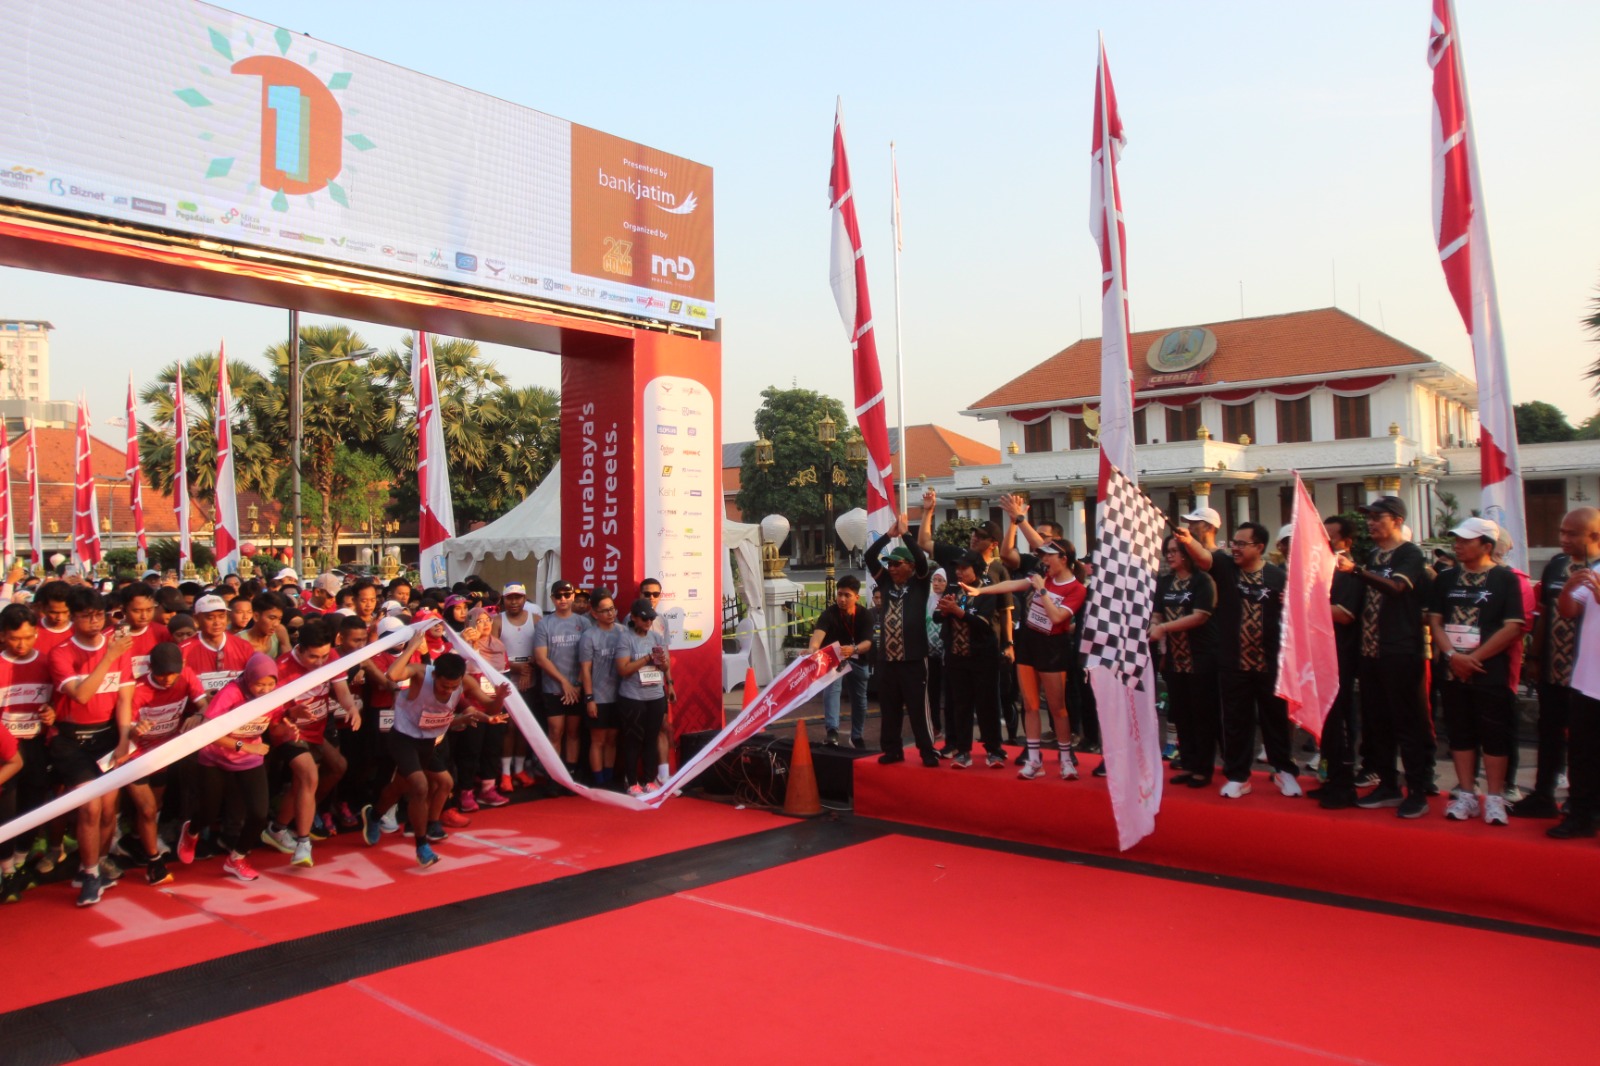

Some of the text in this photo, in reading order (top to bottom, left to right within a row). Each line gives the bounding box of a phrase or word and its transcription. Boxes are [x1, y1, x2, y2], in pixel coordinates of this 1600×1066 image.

[623, 158, 668, 179] Presented by
[70, 185, 105, 201] Biznet
[599, 167, 676, 206] bankjatim
[623, 221, 668, 240] Organized by
[578, 402, 598, 589] he Surabaya's
[602, 422, 621, 600] City Streets.
